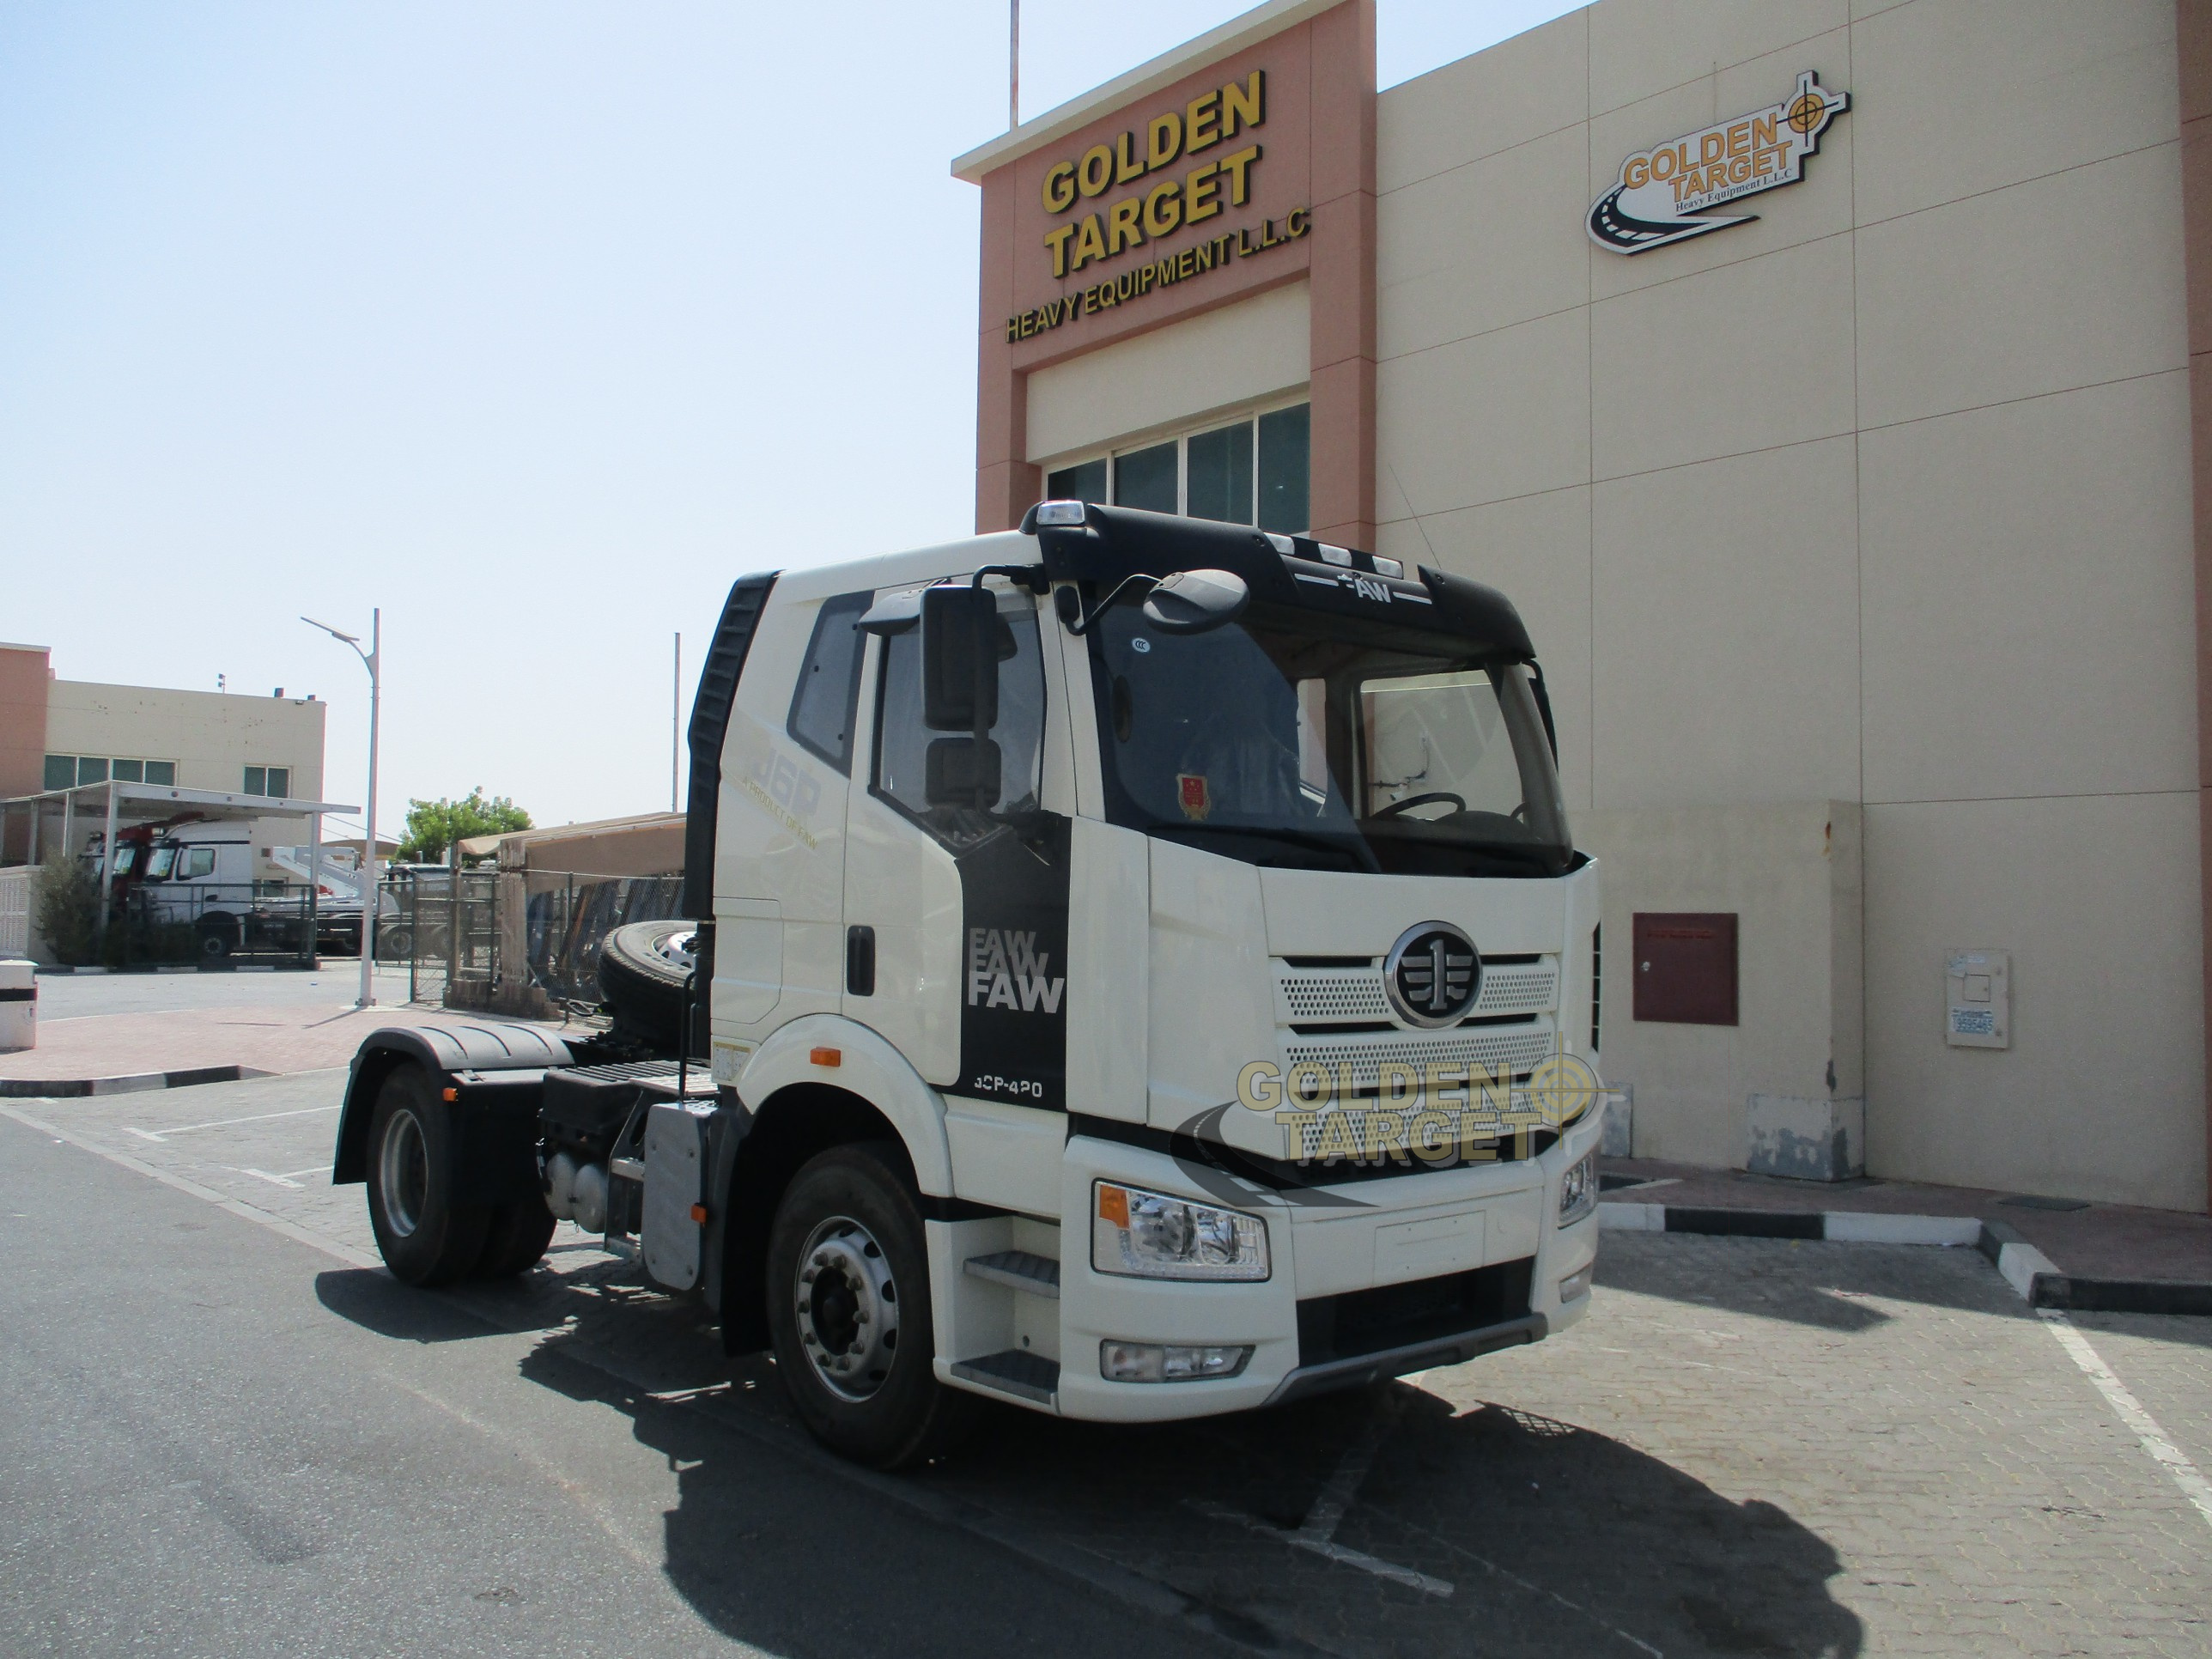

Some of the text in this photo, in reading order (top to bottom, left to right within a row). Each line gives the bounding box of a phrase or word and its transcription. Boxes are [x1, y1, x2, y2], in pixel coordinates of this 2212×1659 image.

[1041, 69, 1266, 215] GOLDEN
[1624, 112, 1778, 190] GOLDEN
[1668, 140, 1792, 203] TARGET
[1043, 144, 1262, 278] TARGET
[1676, 168, 1792, 211] Heavy Equipment L.L.C
[1006, 206, 1310, 343] HEAVY EQUIPMENT L.L.C
[969, 970, 1065, 1013] FAW
